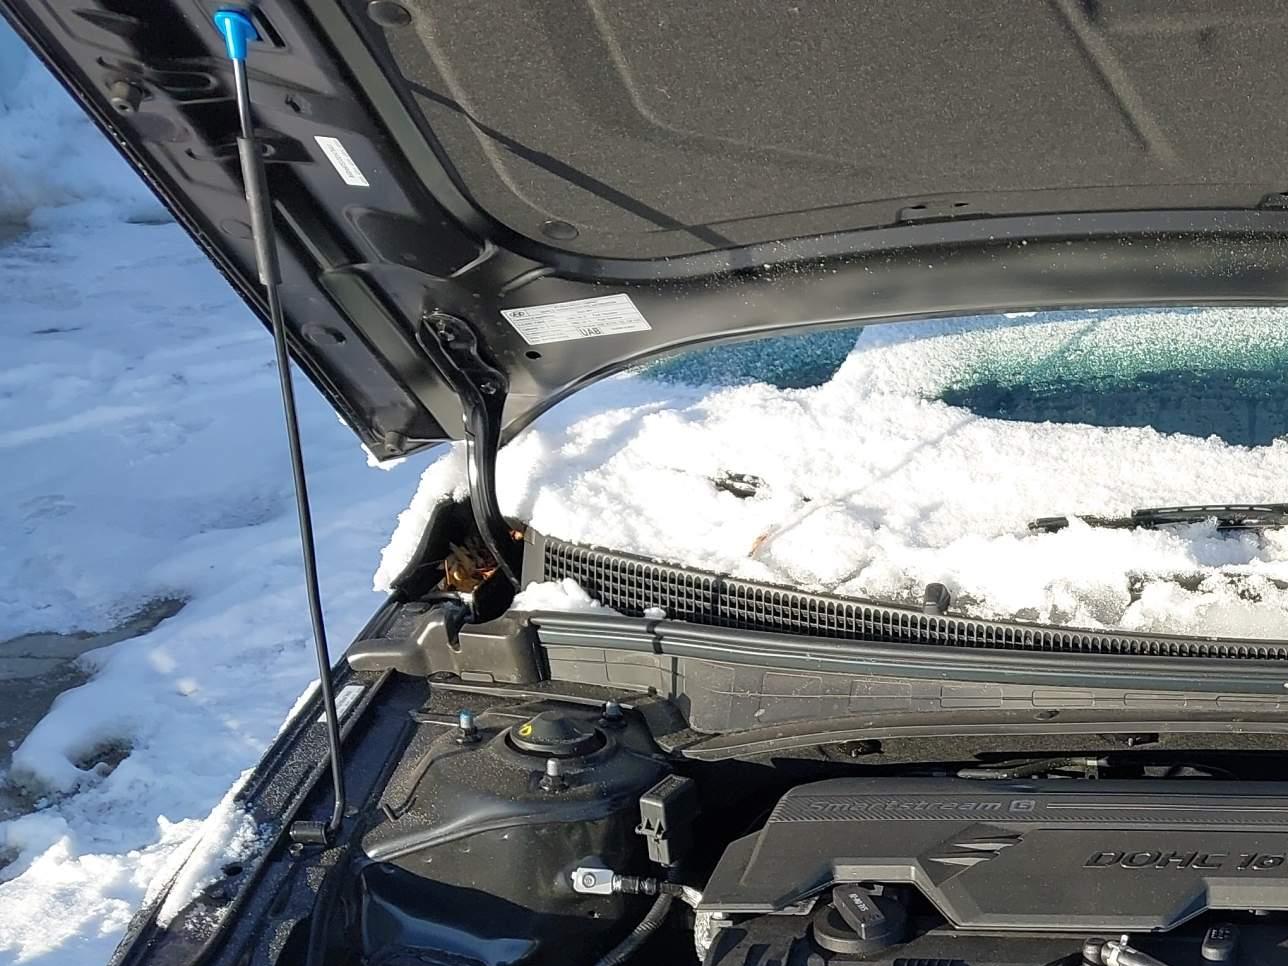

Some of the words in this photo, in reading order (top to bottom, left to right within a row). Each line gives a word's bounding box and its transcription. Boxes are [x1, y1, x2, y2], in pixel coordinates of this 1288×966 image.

[579, 327, 601, 337] UAB
[807, 800, 1002, 812] Smartstream
[1082, 850, 1230, 869] DOHC
